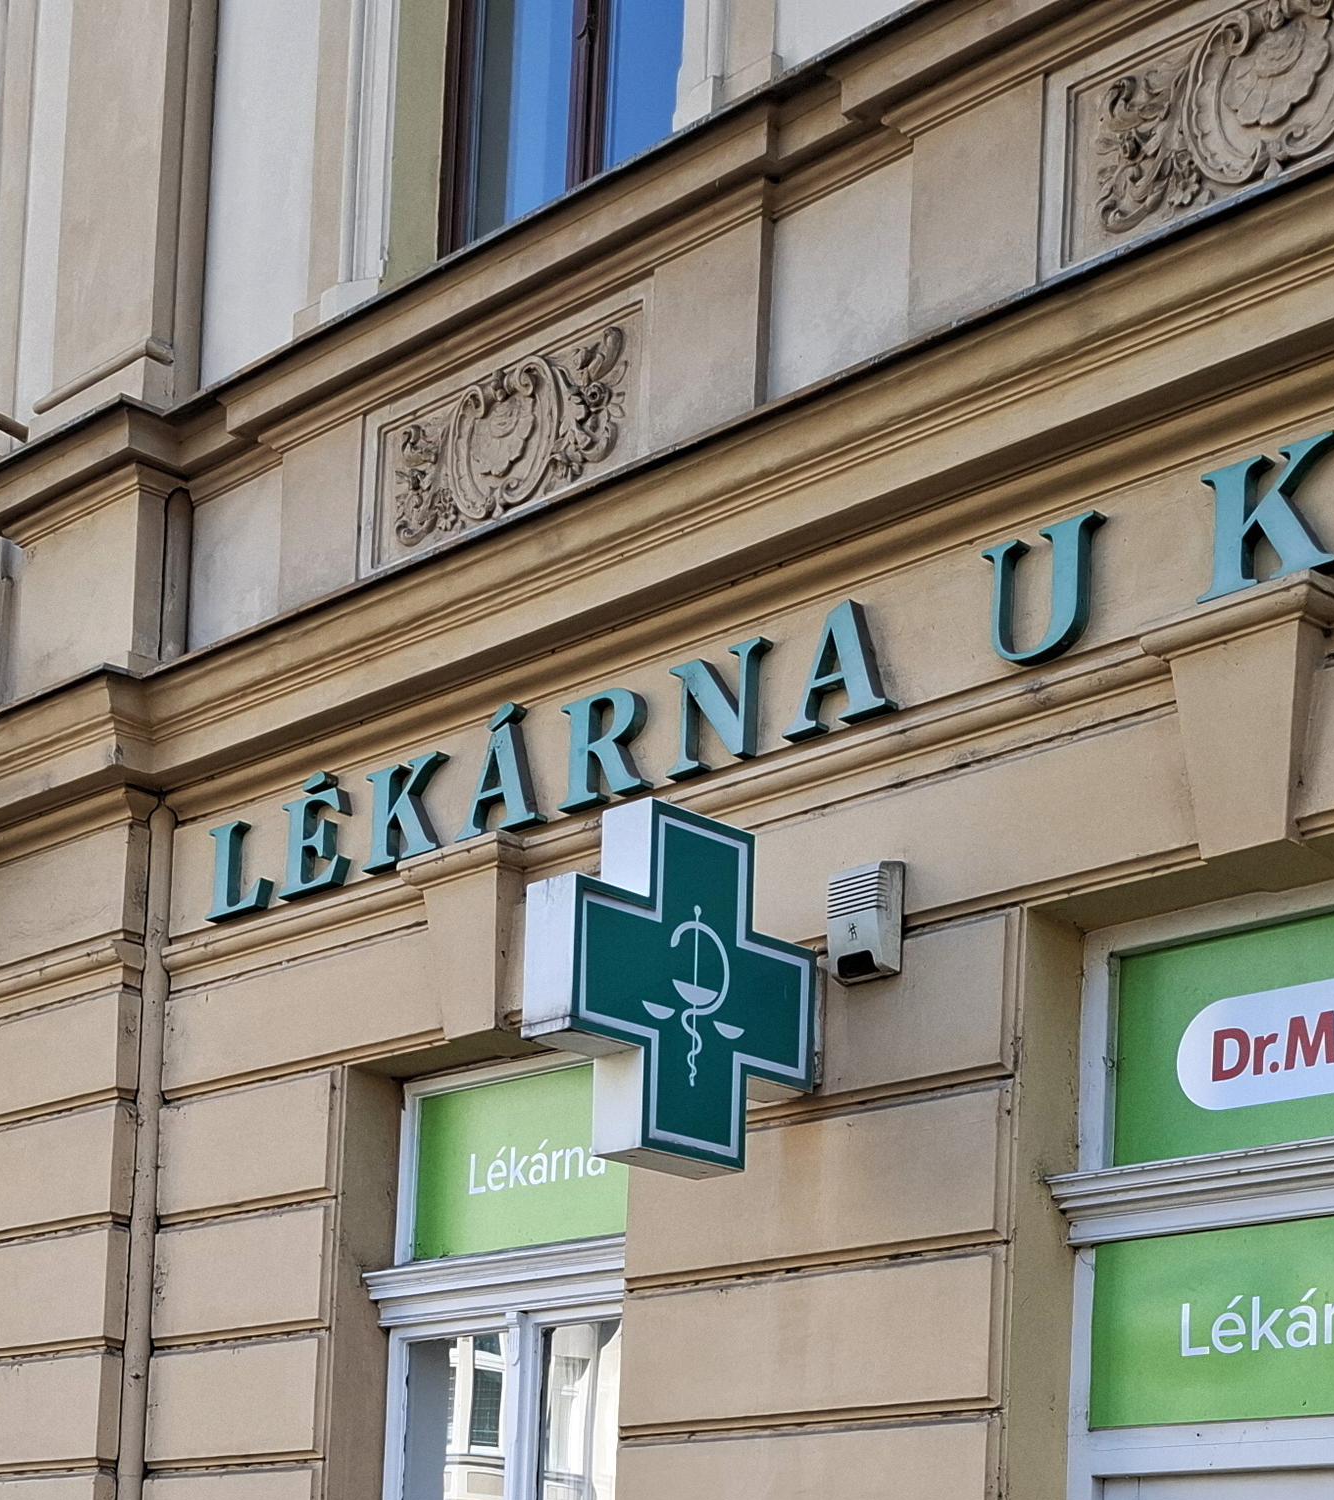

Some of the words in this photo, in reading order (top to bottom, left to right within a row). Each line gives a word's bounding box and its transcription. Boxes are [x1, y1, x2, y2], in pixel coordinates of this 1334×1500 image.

[205, 600, 898, 923] LÉKÁRNA
[981, 511, 1107, 666] U
[469, 1139, 606, 1195] Lékárna
